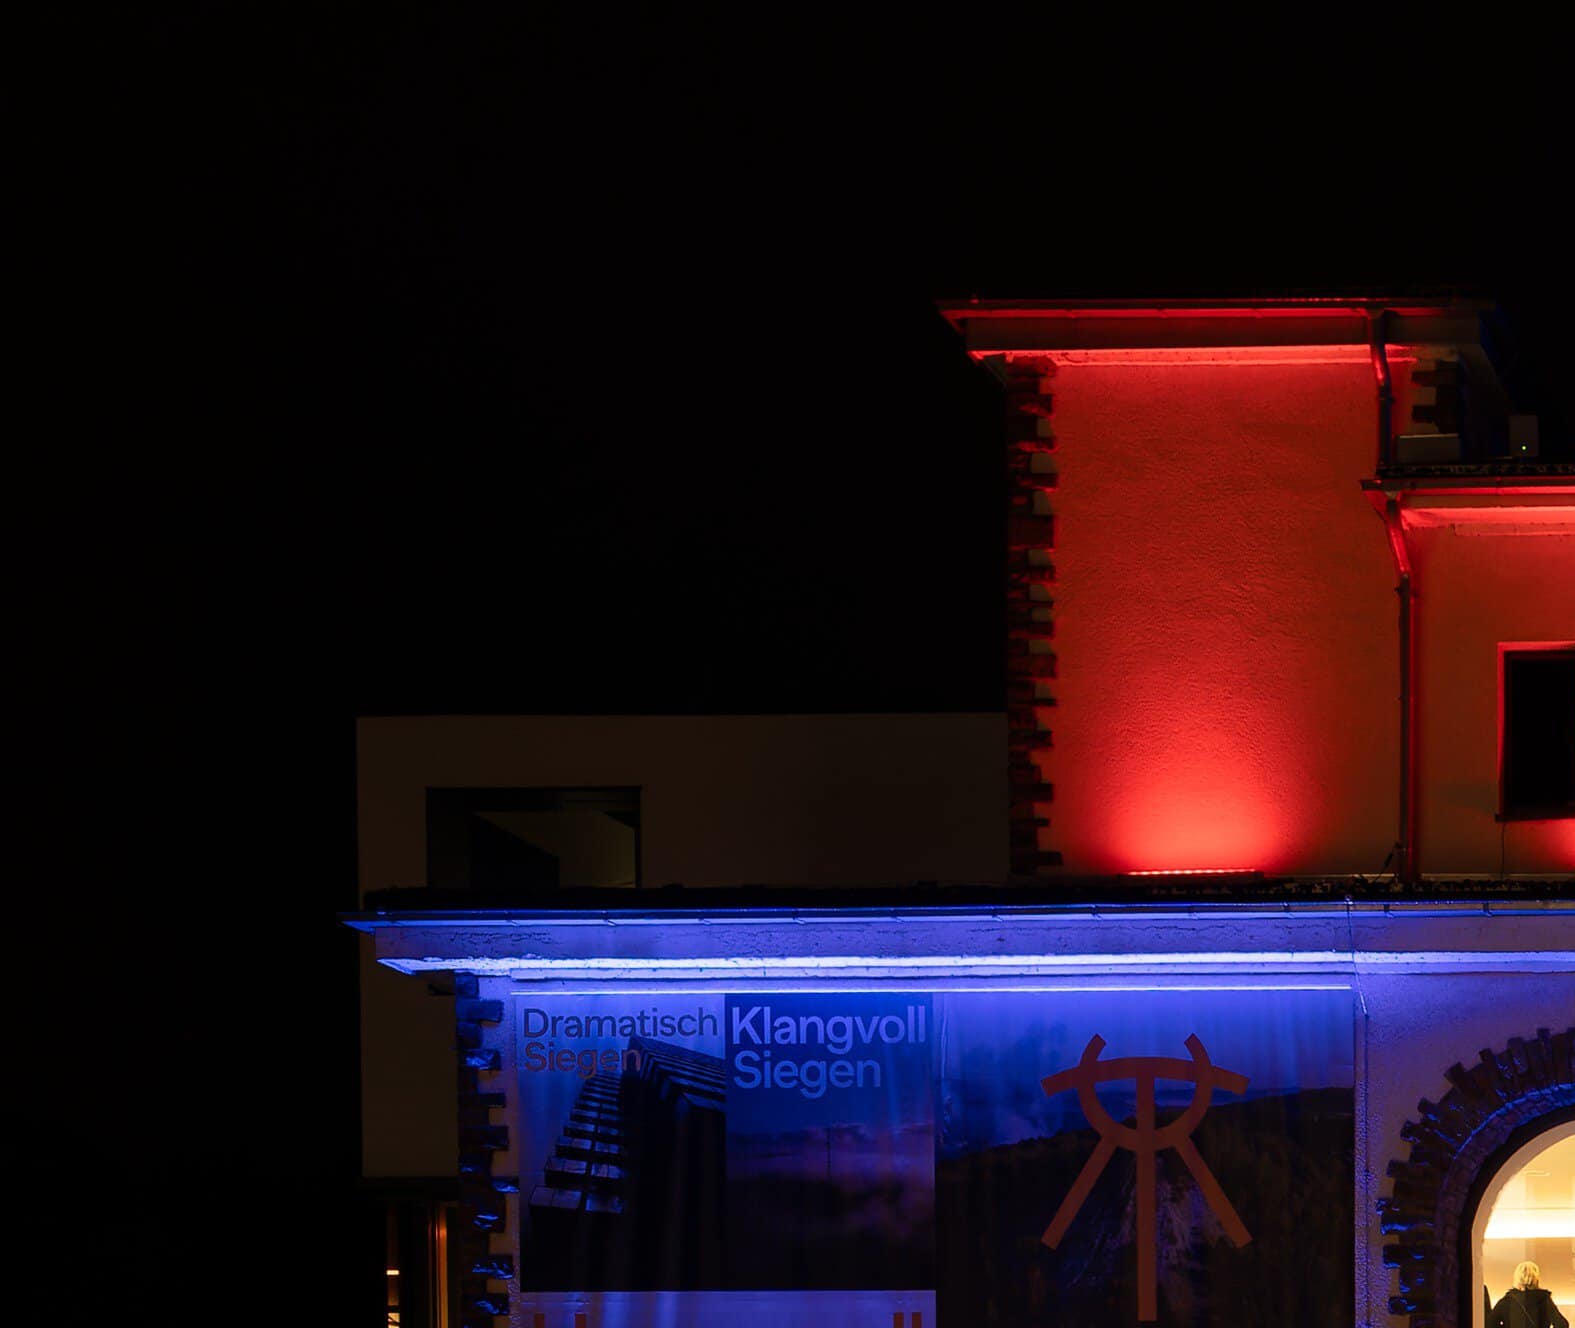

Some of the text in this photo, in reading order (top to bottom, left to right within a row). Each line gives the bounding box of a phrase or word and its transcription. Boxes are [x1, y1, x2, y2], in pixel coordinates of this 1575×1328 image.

[523, 1008, 718, 1038] Dramatisch
[731, 1005, 927, 1055] Klangvoll
[524, 1042, 641, 1079] Siegen
[733, 1050, 882, 1098] Siegen
